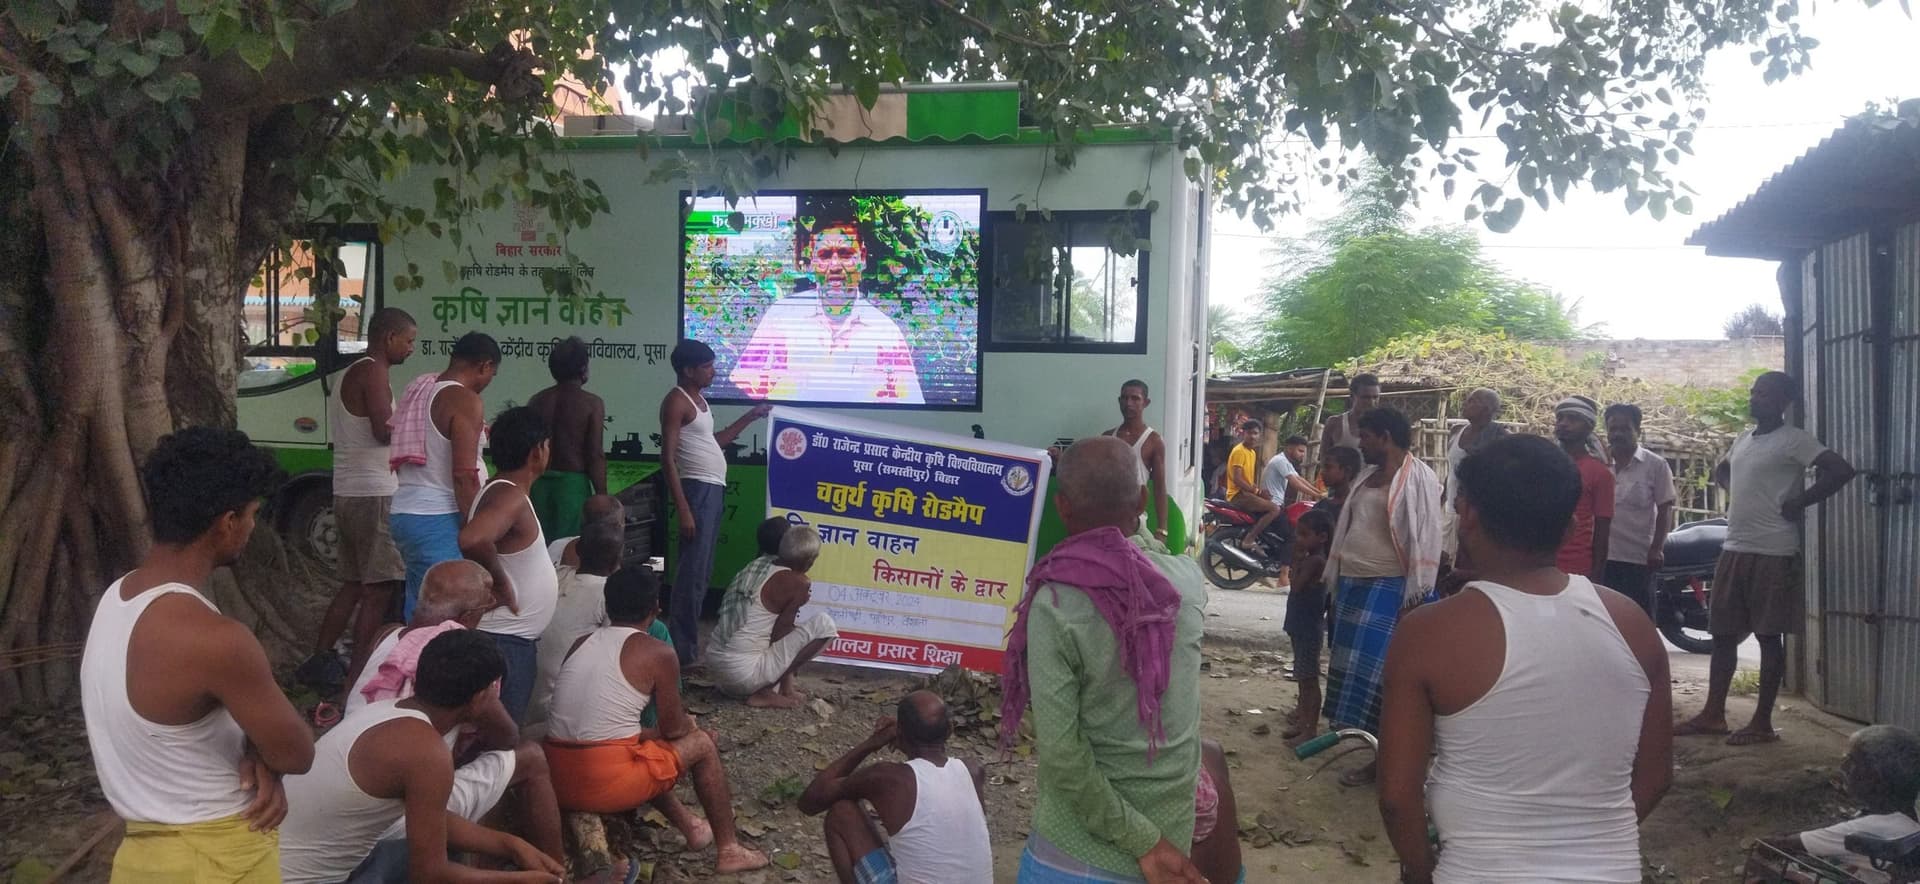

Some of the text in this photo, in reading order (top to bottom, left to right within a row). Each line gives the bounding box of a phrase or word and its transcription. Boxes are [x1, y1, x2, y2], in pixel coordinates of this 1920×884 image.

[496, 242, 561, 257] बिहार सरकार
[519, 263, 529, 277] के
[432, 287, 626, 333] कृषि ज्ञान वाहन
[643, 344, 667, 365] पूसा
[832, 437, 860, 456] राजेन्द्र
[863, 443, 888, 459] प्रसाद
[891, 444, 922, 465] केन्द्रीय
[925, 450, 945, 469] कृषि
[947, 453, 1004, 477] विश्वविद्यालय
[853, 459, 960, 486] पूसा (समस्तीपुर) बिहार
[817, 480, 986, 526] चतुर्थ कृषि रोडमैप
[817, 524, 920, 555] ज्ञान वाहन
[873, 558, 1008, 600] किसानों के द्वार
[877, 642, 919, 660] प्रसार
[923, 643, 963, 665] शिक्षा
